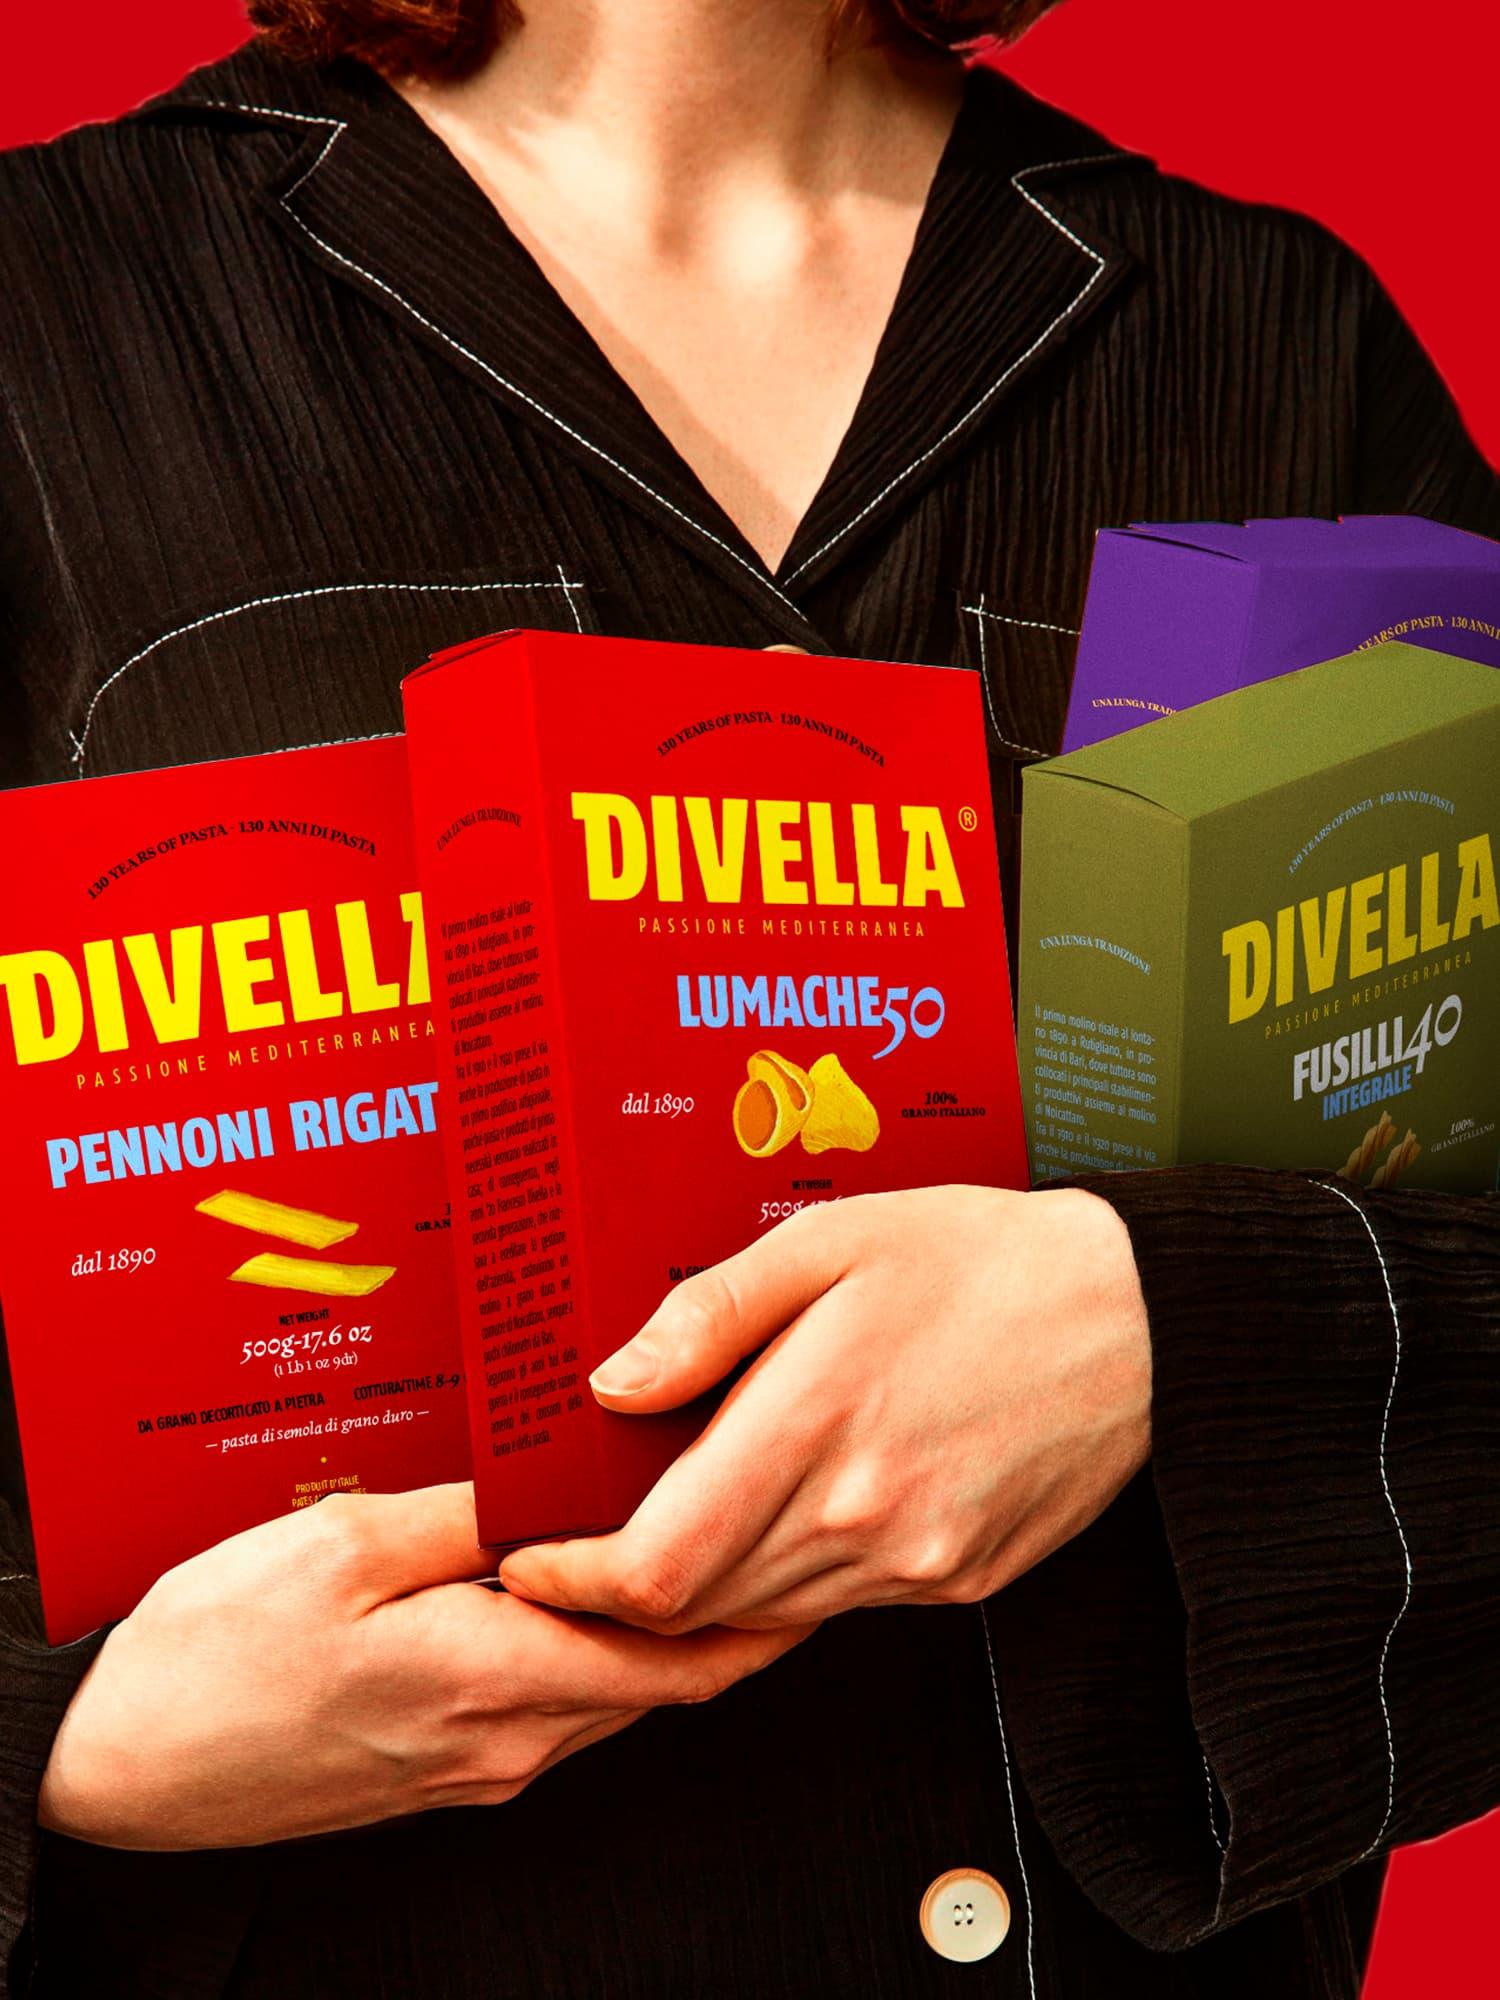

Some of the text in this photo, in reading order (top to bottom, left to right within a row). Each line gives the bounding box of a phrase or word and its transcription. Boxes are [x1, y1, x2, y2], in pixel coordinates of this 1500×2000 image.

[1394, 621, 1410, 636] OF
[1410, 615, 1444, 631] PASTA
[1451, 616, 1468, 628] 130
[1467, 620, 1495, 639] ANNI
[1092, 698, 1176, 716] UNA LUNGA TRAD
[657, 711, 885, 769] 130 YEARS OF PASTA 130 ANNI DI PASTA
[88, 820, 378, 900] 130 YEARS OF PASTA 130 ANNI DI PASTA
[570, 791, 966, 908] DIVELLA
[639, 916, 926, 938] PASSIONE MEDITERRANEA
[1222, 833, 1500, 1024] DIVELLA
[1264, 951, 1473, 1040] PASSIONE MEDITERRANEA
[77, 1056, 207, 1089] PASSIONE
[229, 1020, 436, 1065] MEDITERRANEA
[621, 1092, 694, 1118] dal 1890
[925, 1091, 959, 1105] 100%
[1322, 1064, 1412, 1120] INTEGRALE
[901, 1106, 987, 1119] GRANO ITALIANO
[46, 1107, 274, 1189] PENNONI
[71, 1246, 156, 1277] dal 1890
[669, 1267, 684, 1281] DA
[279, 1308, 330, 1326] NET WEIGHT
[348, 1323, 373, 1342] oz
[273, 1352, 358, 1378] (1 Lb 1 oz 9dr)
[138, 1391, 326, 1435] DA GRANO DECORTICATO A PIETRA
[221, 1407, 414, 1453] pasta di semola di grano duro
[296, 1479, 328, 1493] PRODUIT
